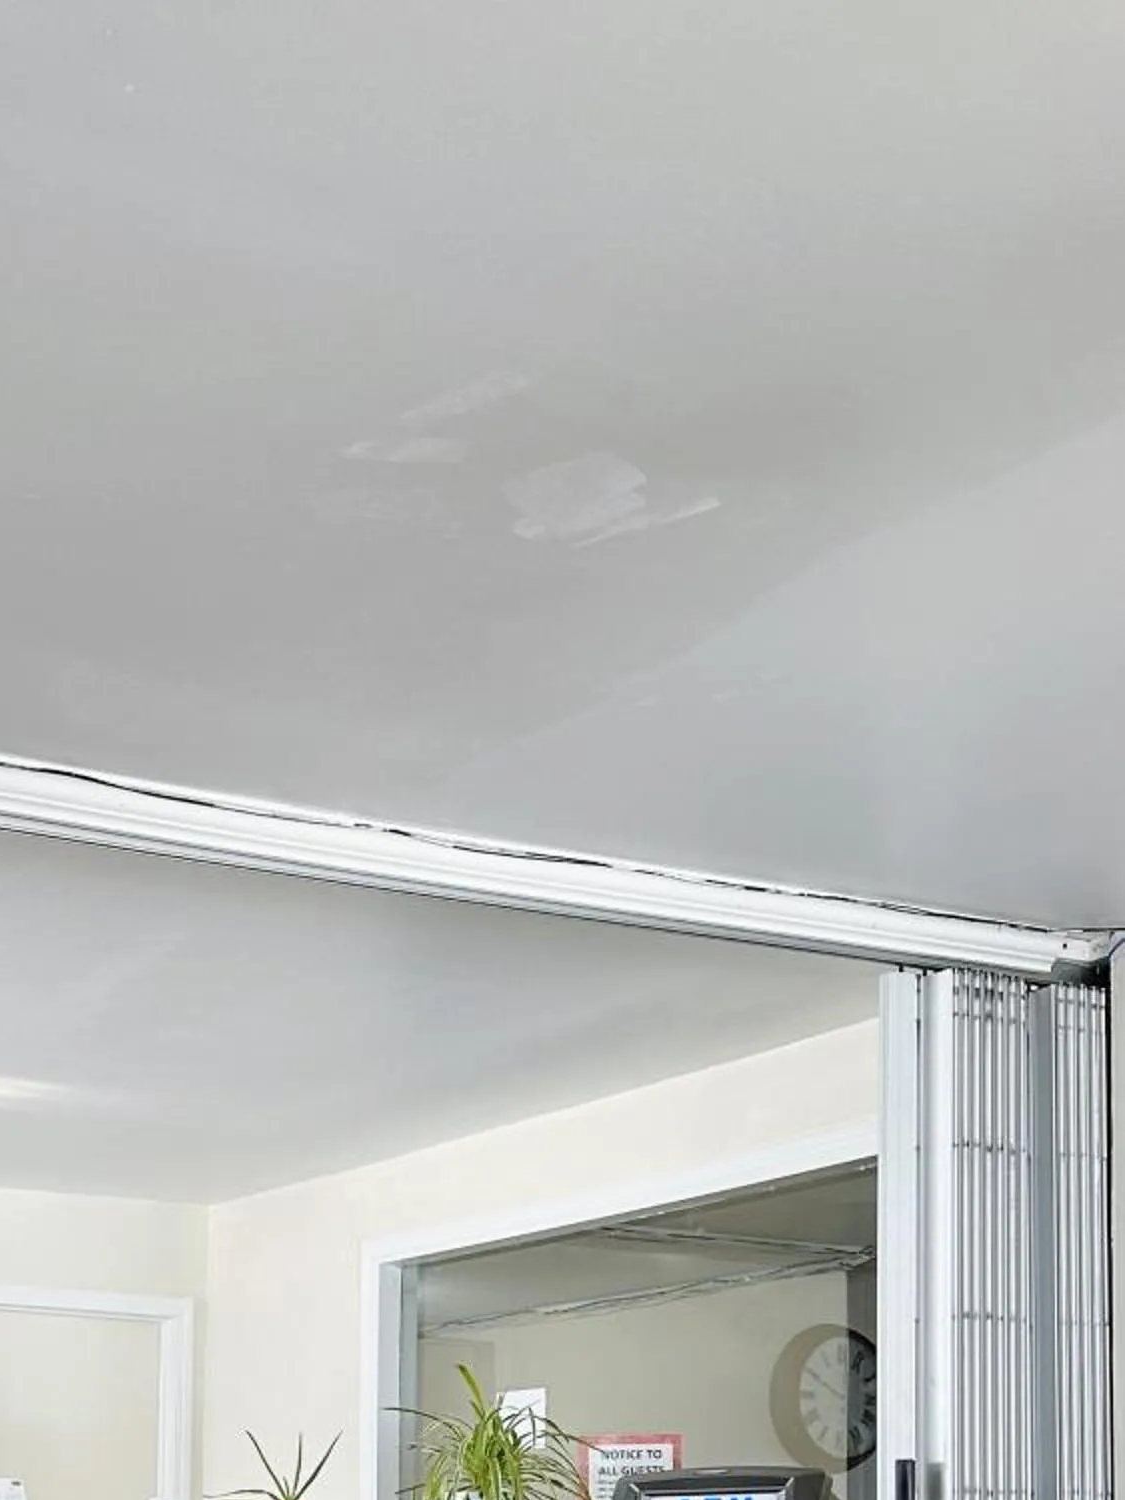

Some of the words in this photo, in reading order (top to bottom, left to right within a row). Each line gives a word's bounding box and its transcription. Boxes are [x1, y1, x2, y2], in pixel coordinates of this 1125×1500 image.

[602, 1449, 643, 1460] NOTICE
[646, 1449, 662, 1460] TO
[598, 1466, 617, 1475] ALL
